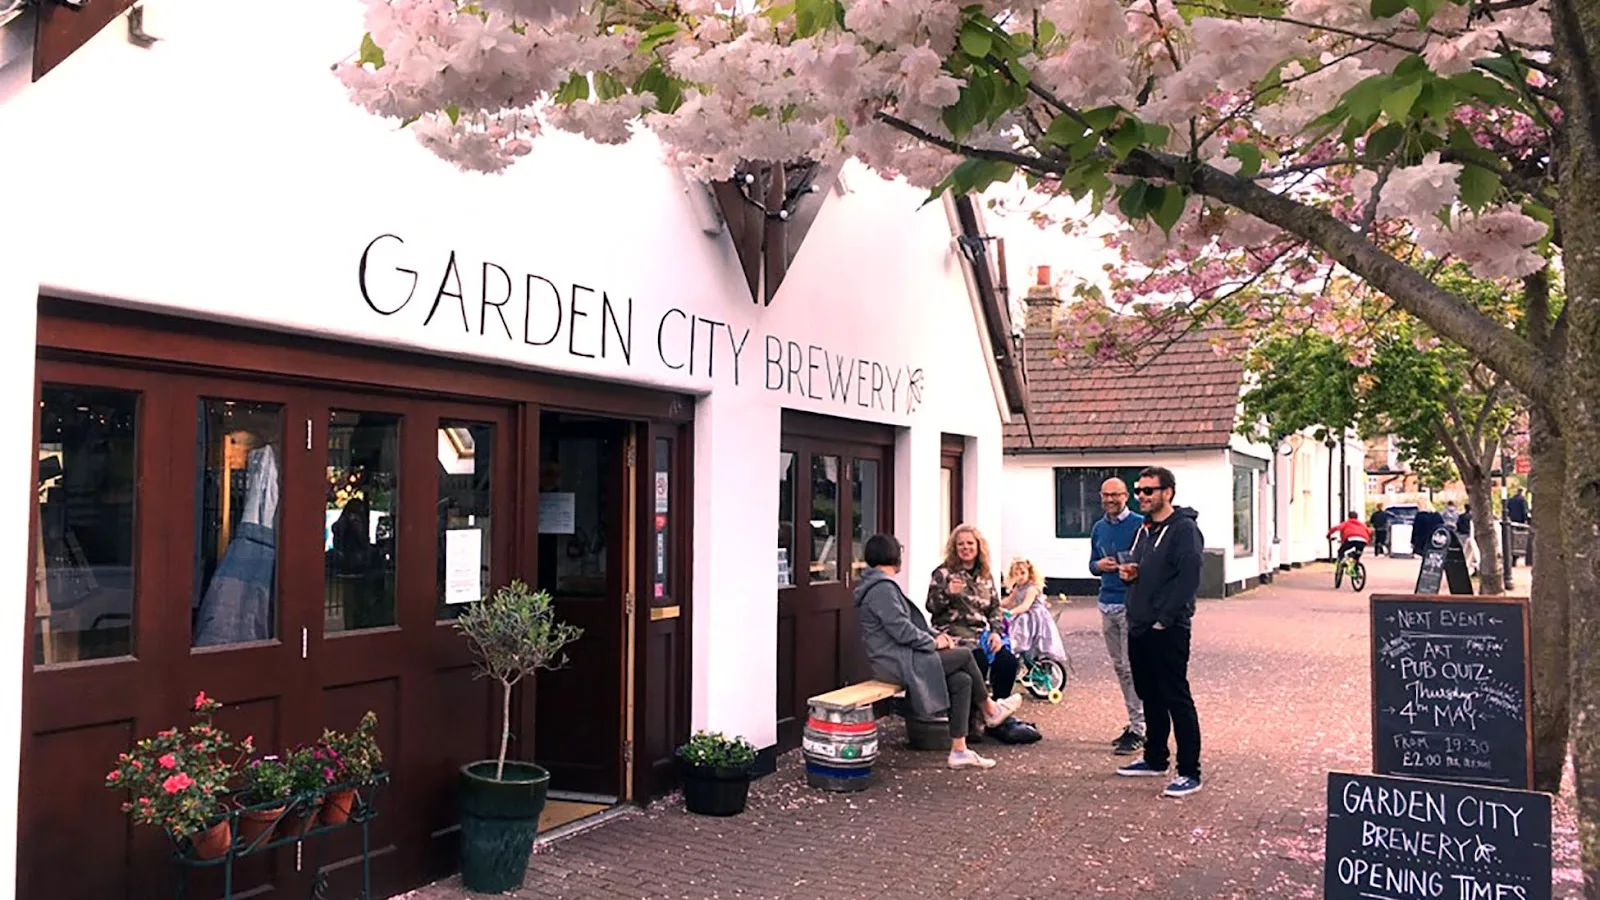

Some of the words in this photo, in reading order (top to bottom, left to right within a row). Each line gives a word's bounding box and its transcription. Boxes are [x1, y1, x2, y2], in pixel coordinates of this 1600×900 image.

[358, 233, 632, 366] GARDEN
[657, 308, 750, 386] CITY
[765, 334, 902, 409] BREWERY
[1398, 608, 1432, 630] NEXT
[1440, 609, 1486, 627] EVENT
[1423, 641, 1453, 659] ART
[1400, 657, 1437, 680] PUB
[1441, 661, 1490, 684] QUIZ
[1405, 680, 1480, 712] Thursday
[1434, 704, 1477, 731] MAY
[1393, 733, 1430, 750] FROM
[1444, 736, 1490, 755] 19:30
[1343, 780, 1446, 825] GARDEN
[1457, 795, 1524, 837] CITY
[1362, 820, 1472, 863] BREWERY
[1337, 856, 1444, 898] OPENING
